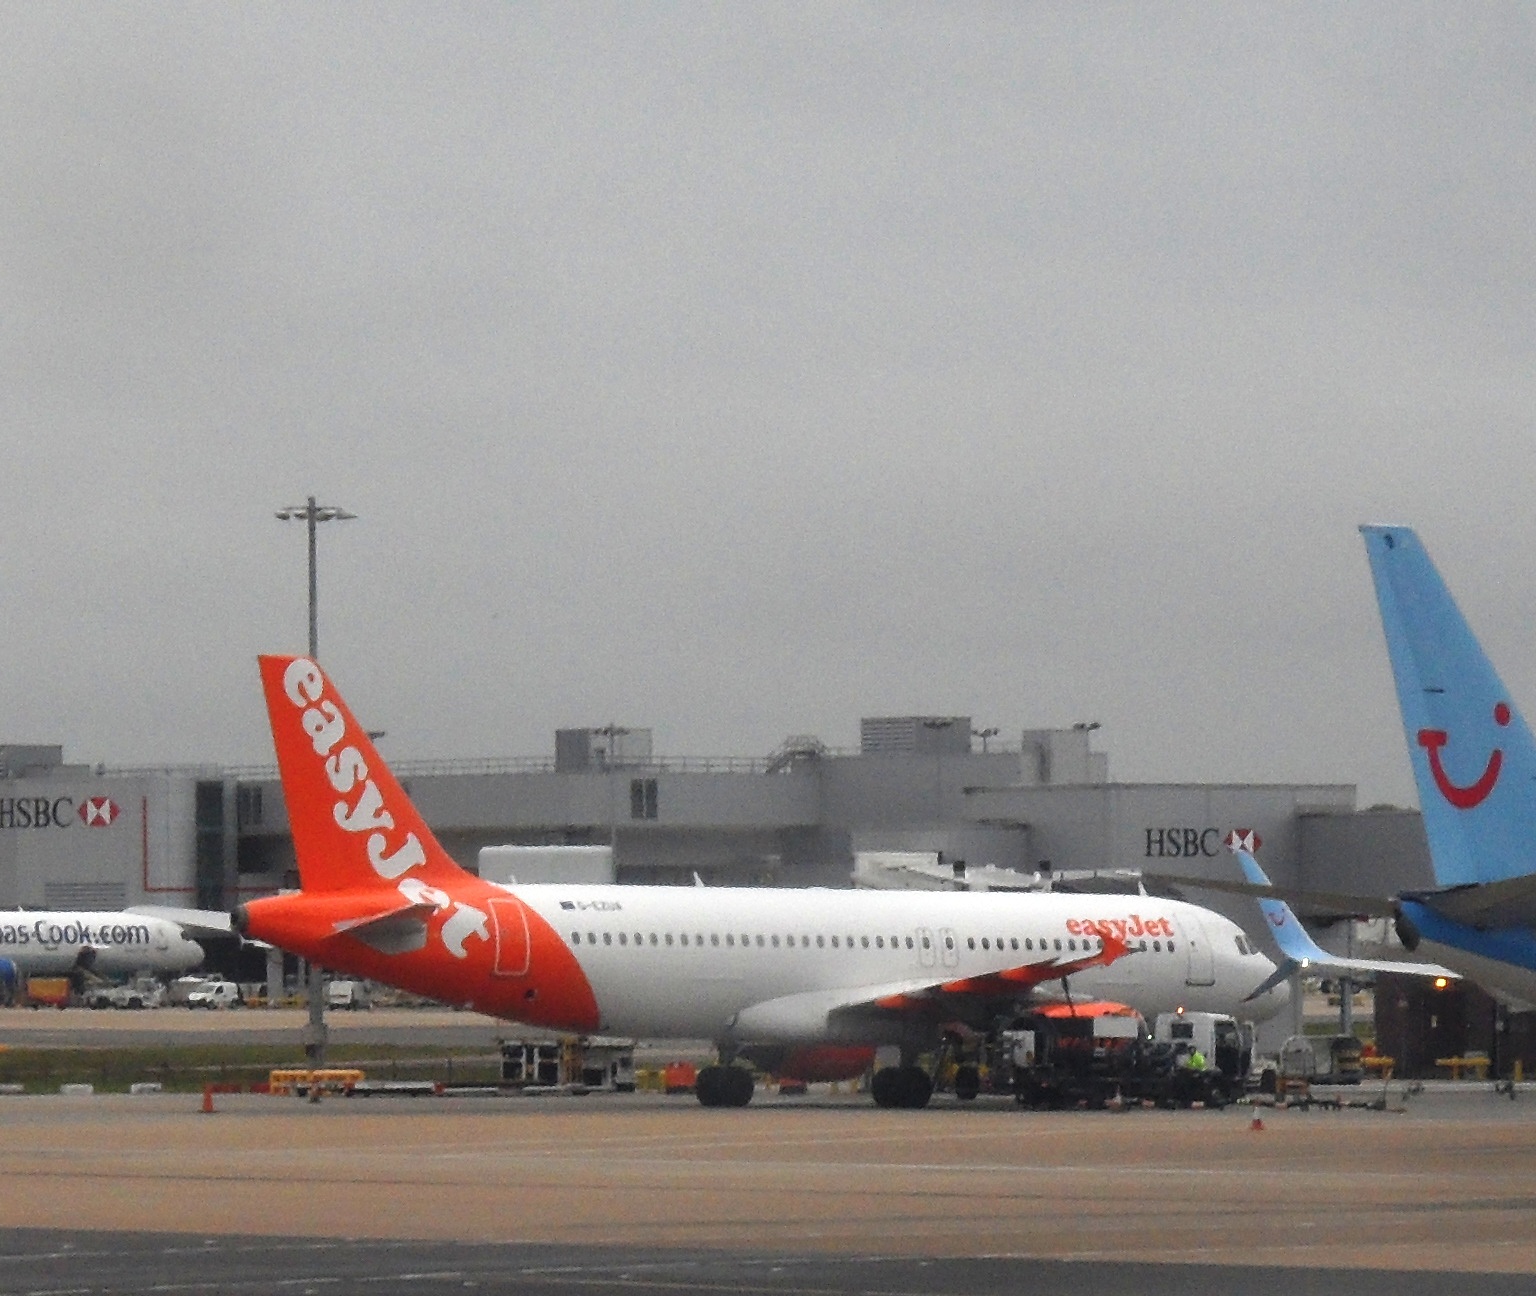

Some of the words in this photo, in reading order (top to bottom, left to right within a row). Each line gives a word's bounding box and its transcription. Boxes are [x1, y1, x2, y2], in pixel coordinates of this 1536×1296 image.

[283, 658, 490, 960] easyJet
[1145, 827, 1220, 858] HSBC
[1066, 914, 1175, 943] easyJet
